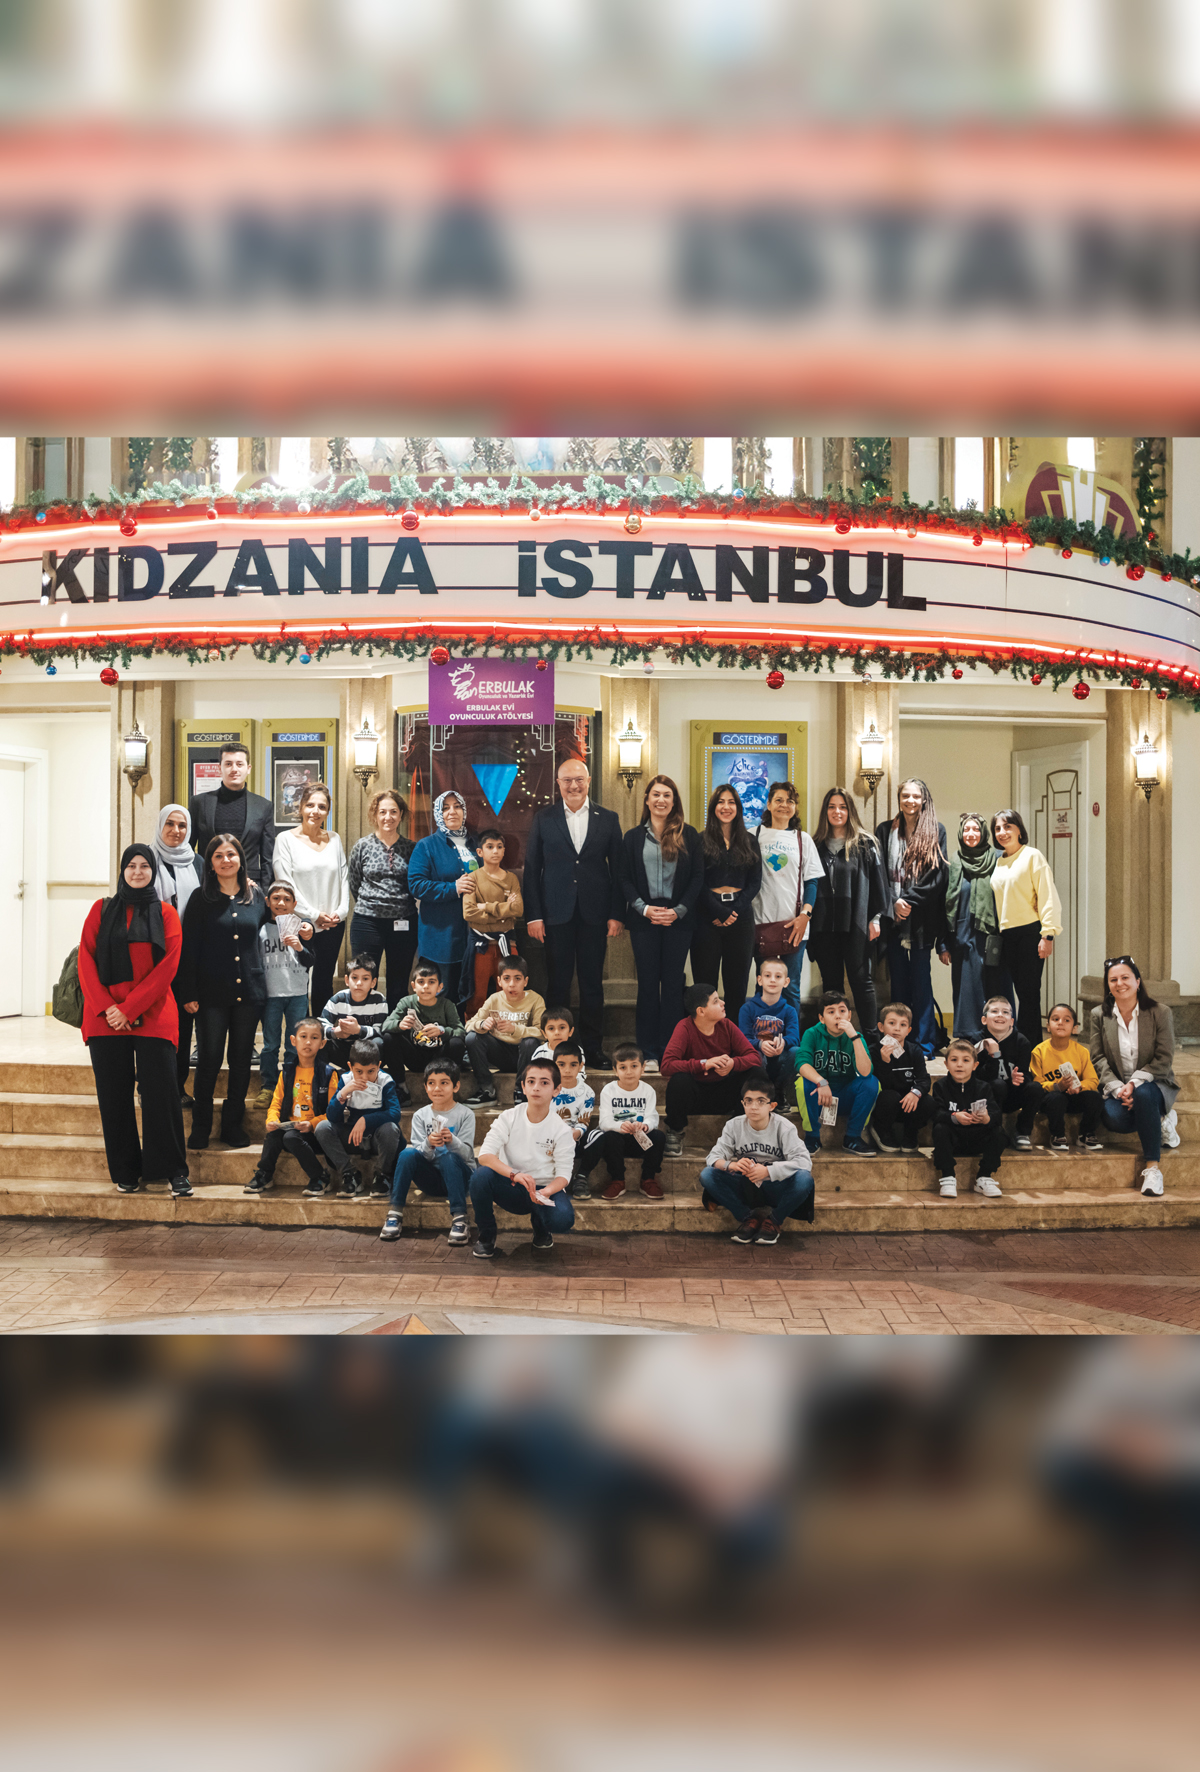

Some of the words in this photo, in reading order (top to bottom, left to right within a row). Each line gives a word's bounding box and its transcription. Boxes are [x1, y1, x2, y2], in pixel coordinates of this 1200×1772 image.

[41, 537, 439, 605] KIDZANIA
[478, 681, 535, 694] ERBULAK
[502, 703, 515, 711] EVİ
[497, 711, 534, 720] ATÖLYESİ
[813, 1050, 851, 1074] GAP
